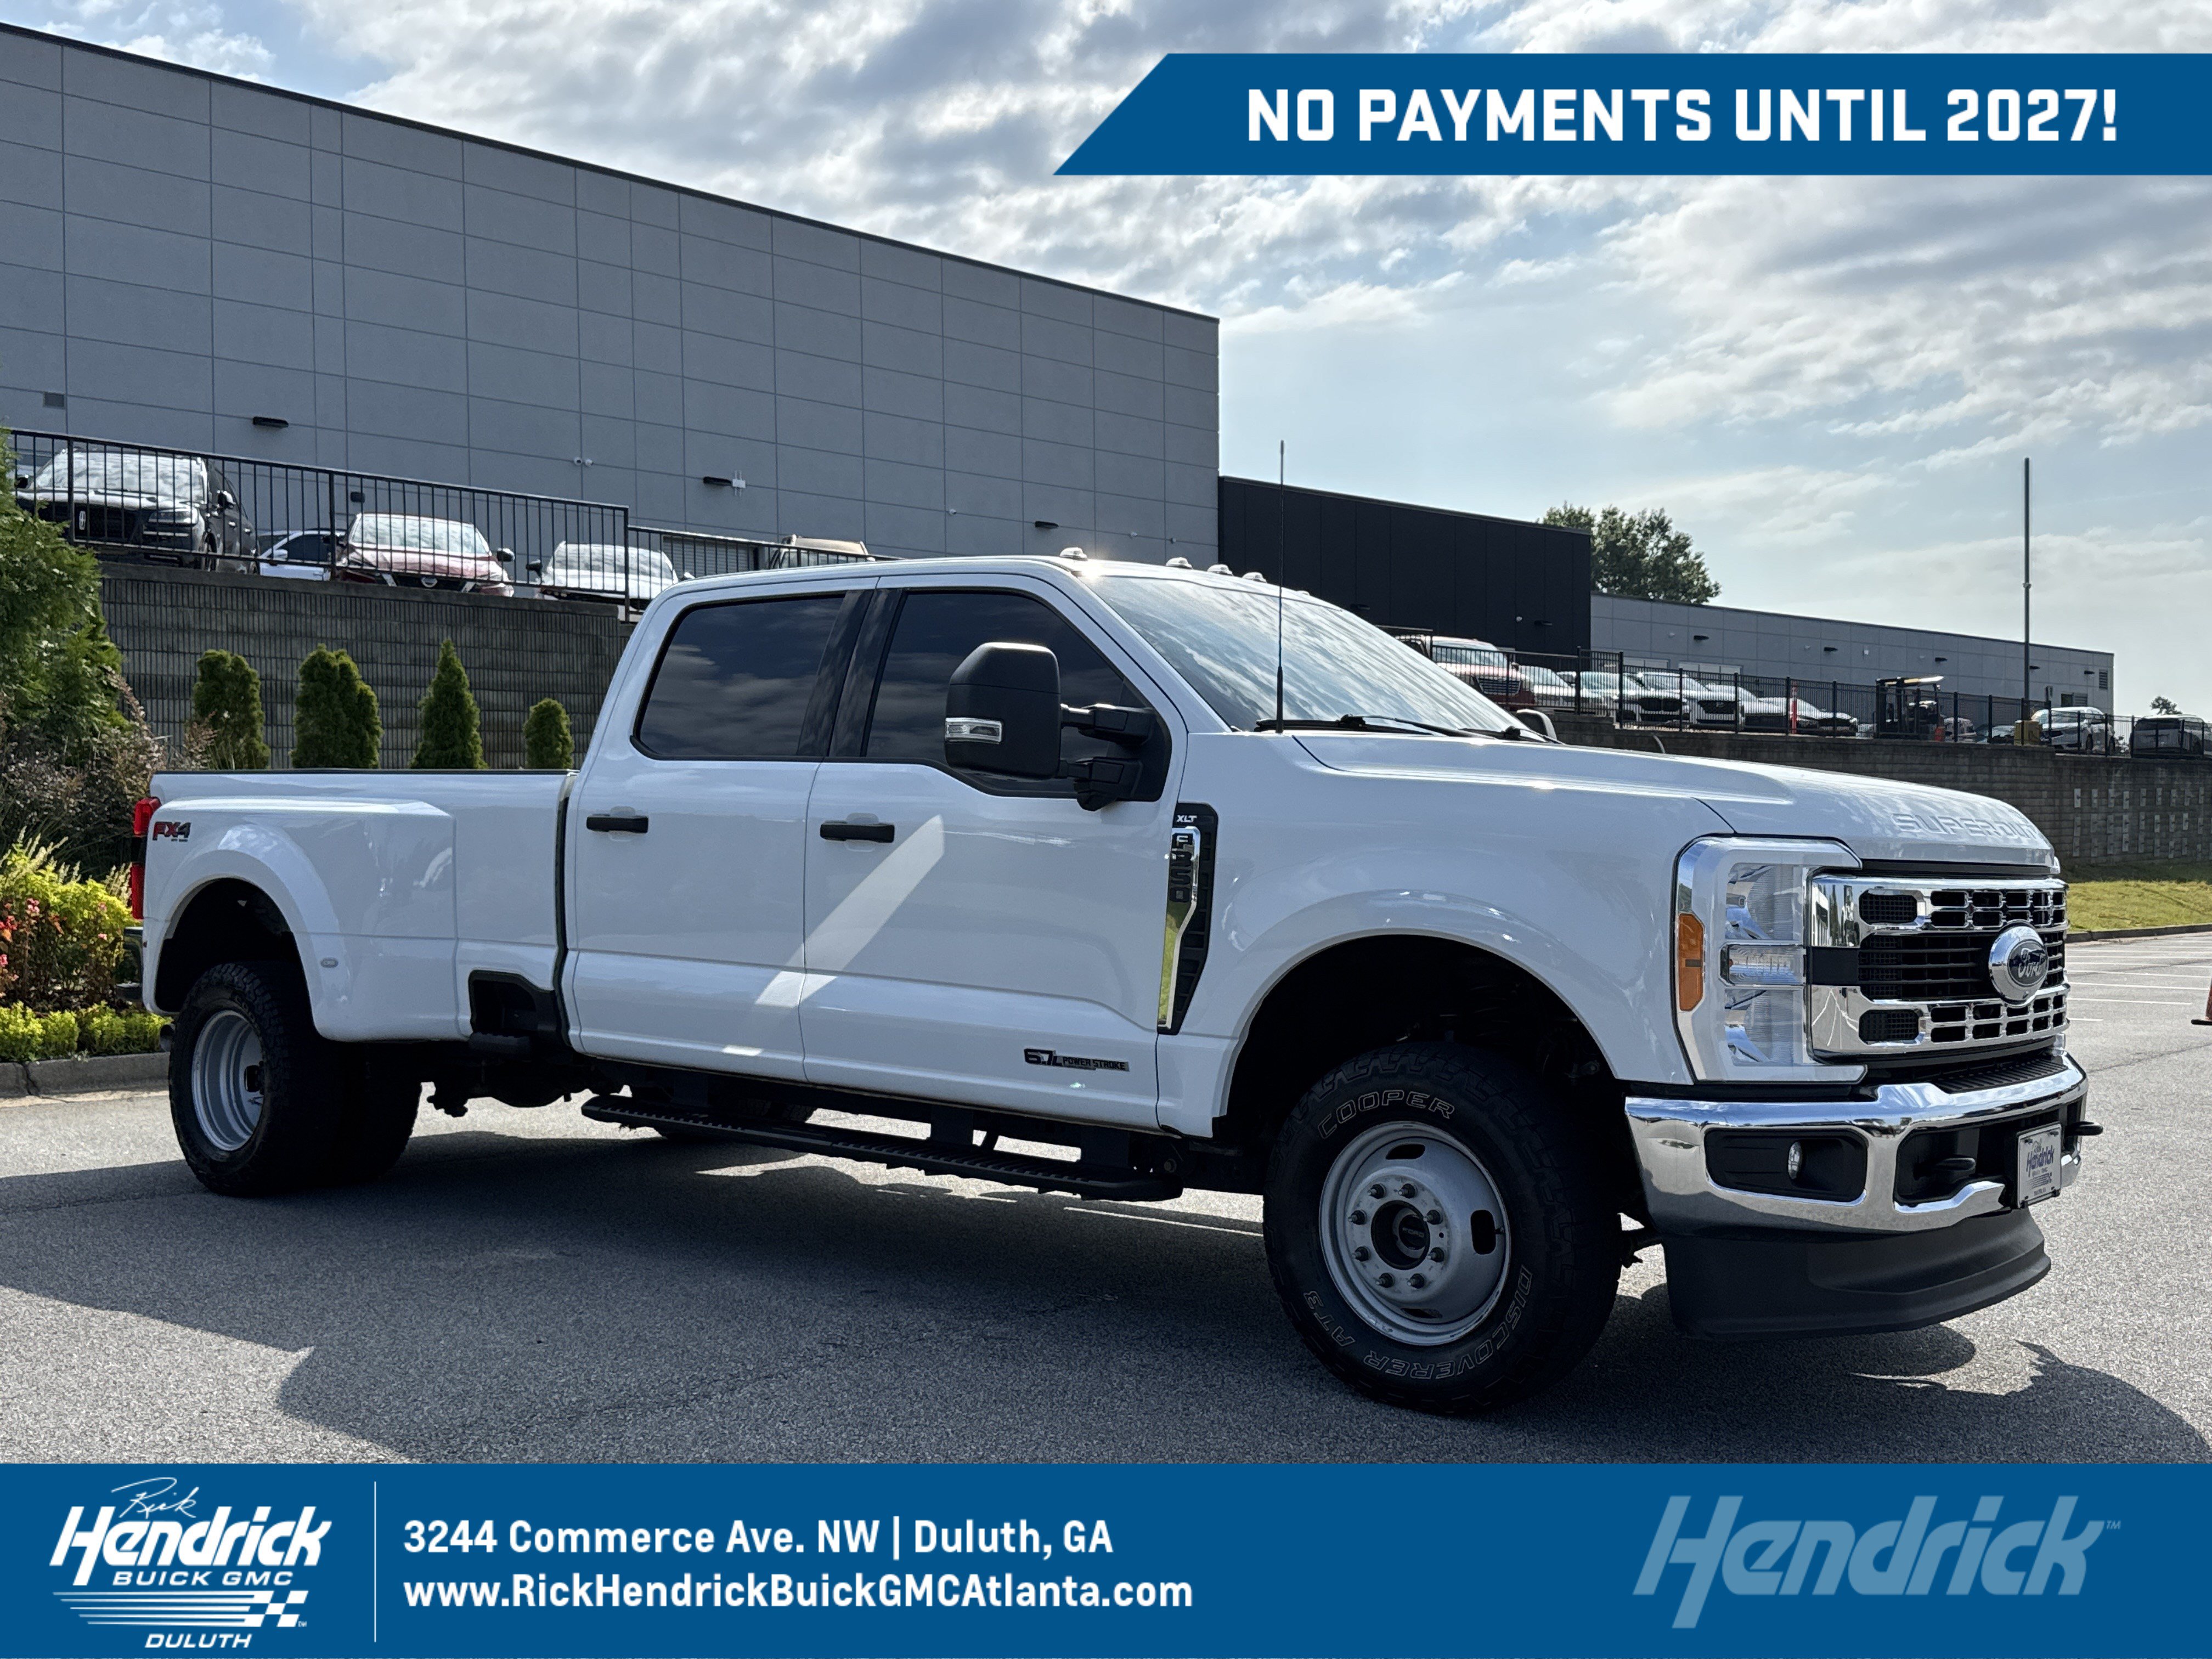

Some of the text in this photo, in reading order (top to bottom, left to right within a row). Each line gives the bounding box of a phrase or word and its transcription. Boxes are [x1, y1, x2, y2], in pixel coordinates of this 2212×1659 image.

[1176, 814, 1198, 822] XLT
[1892, 813, 2001, 837] SUPER
[152, 821, 192, 841] FX4
[2017, 947, 2047, 978] Ford
[1062, 1056, 1091, 1066] POWER
[1092, 1059, 1125, 1070] STROKE
[1317, 1088, 1457, 1140] COOPER
[1302, 1264, 1534, 1381] DISCOVERER AT3
